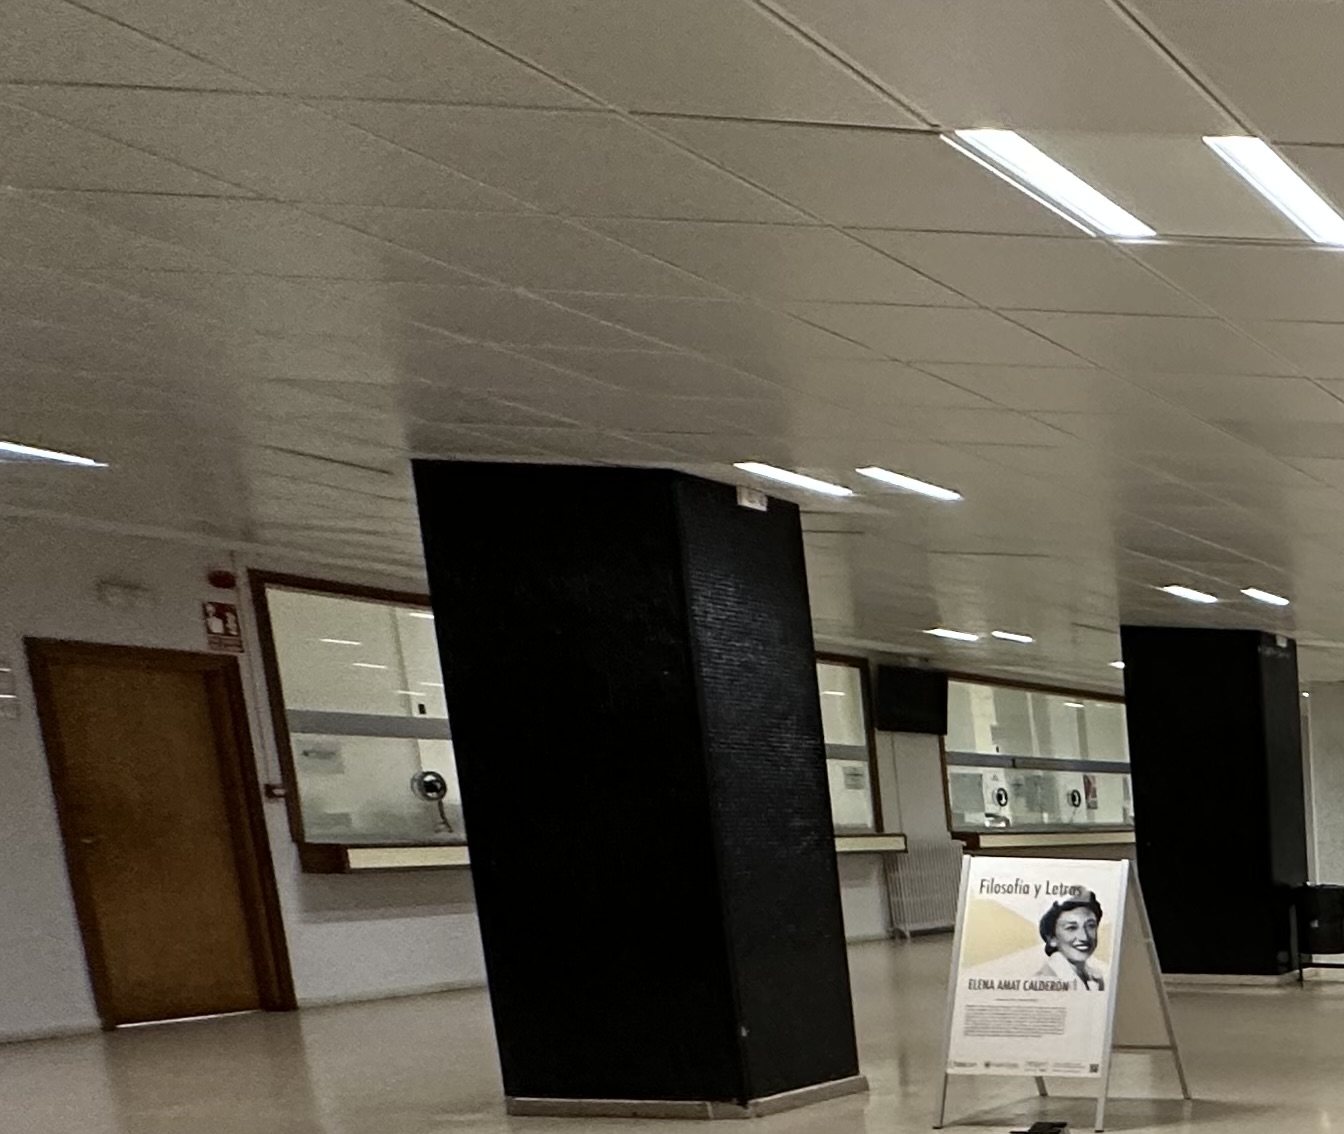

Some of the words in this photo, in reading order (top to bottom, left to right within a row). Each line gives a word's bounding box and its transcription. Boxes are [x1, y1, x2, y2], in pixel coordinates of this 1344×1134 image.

[1034, 884, 1042, 899] y
[1045, 880, 1082, 897] Letras
[968, 979, 995, 991] ELENA
[997, 980, 1021, 991] AMAT
